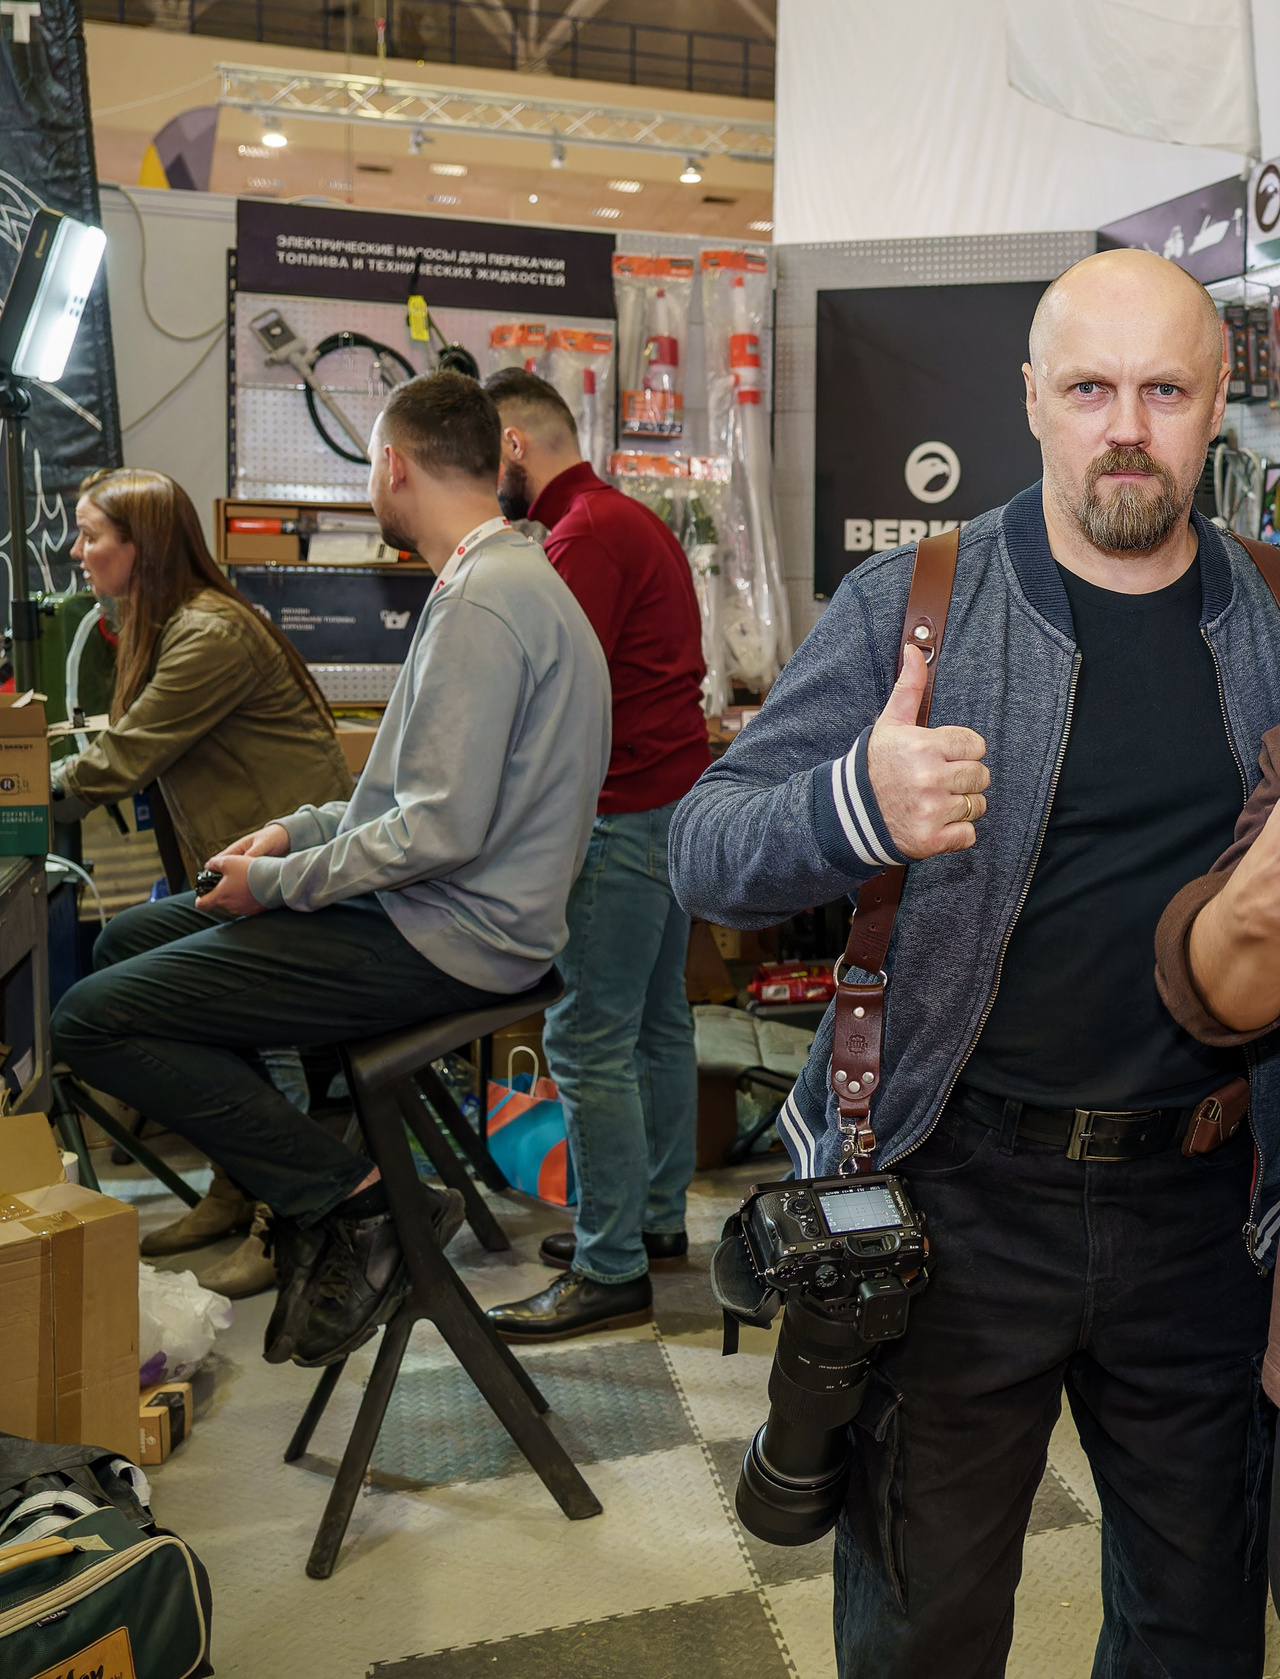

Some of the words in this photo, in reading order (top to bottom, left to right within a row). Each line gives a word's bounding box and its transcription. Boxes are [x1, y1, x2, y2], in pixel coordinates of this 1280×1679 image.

[276, 234, 395, 257] ЭЛЕКТРИЧЕСКИЕ
[458, 252, 486, 265] ДЛЯ
[488, 253, 565, 272] ПЕРЕКАЧКИ
[276, 251, 349, 269] ТОПЛИВА
[352, 259, 364, 270] И
[476, 265, 566, 287] ЖИДКОСТЕЙ
